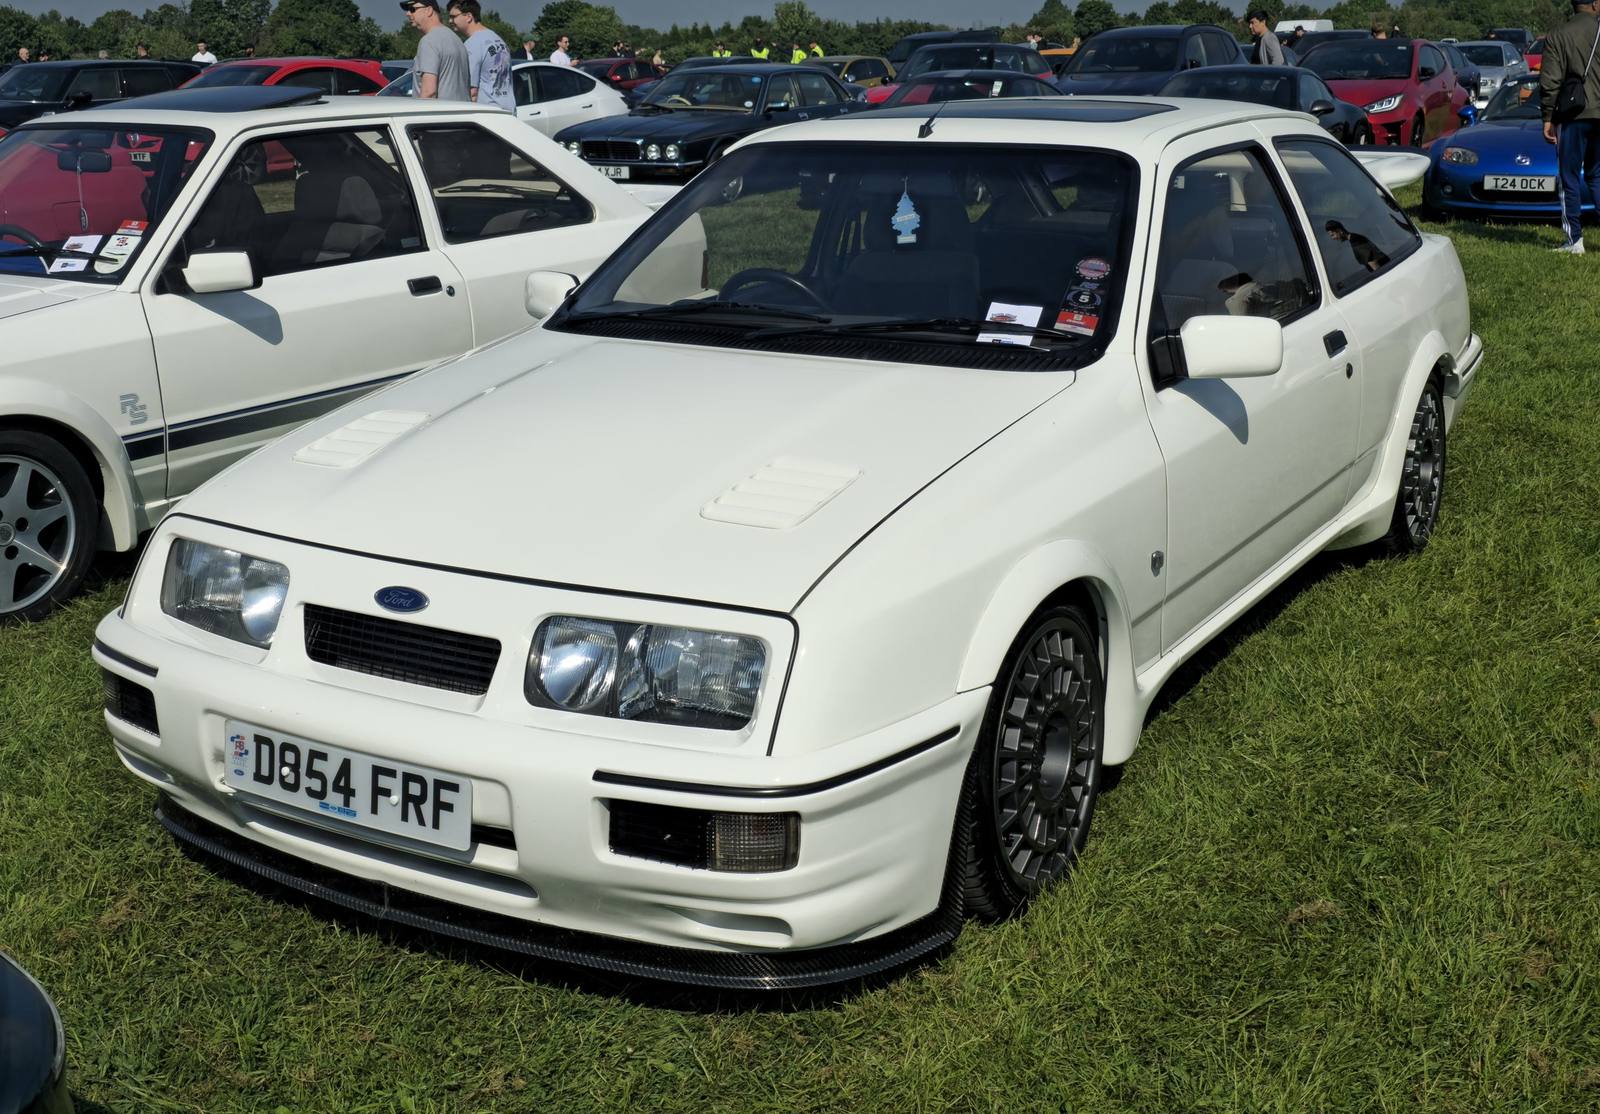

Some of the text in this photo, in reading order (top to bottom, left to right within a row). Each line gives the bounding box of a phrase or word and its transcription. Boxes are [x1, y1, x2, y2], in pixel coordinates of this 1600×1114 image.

[604, 167, 622, 177] XJR
[1493, 178, 1545, 190] T24 OCK
[384, 590, 415, 608] Ford
[253, 734, 460, 830] D854 FRF
